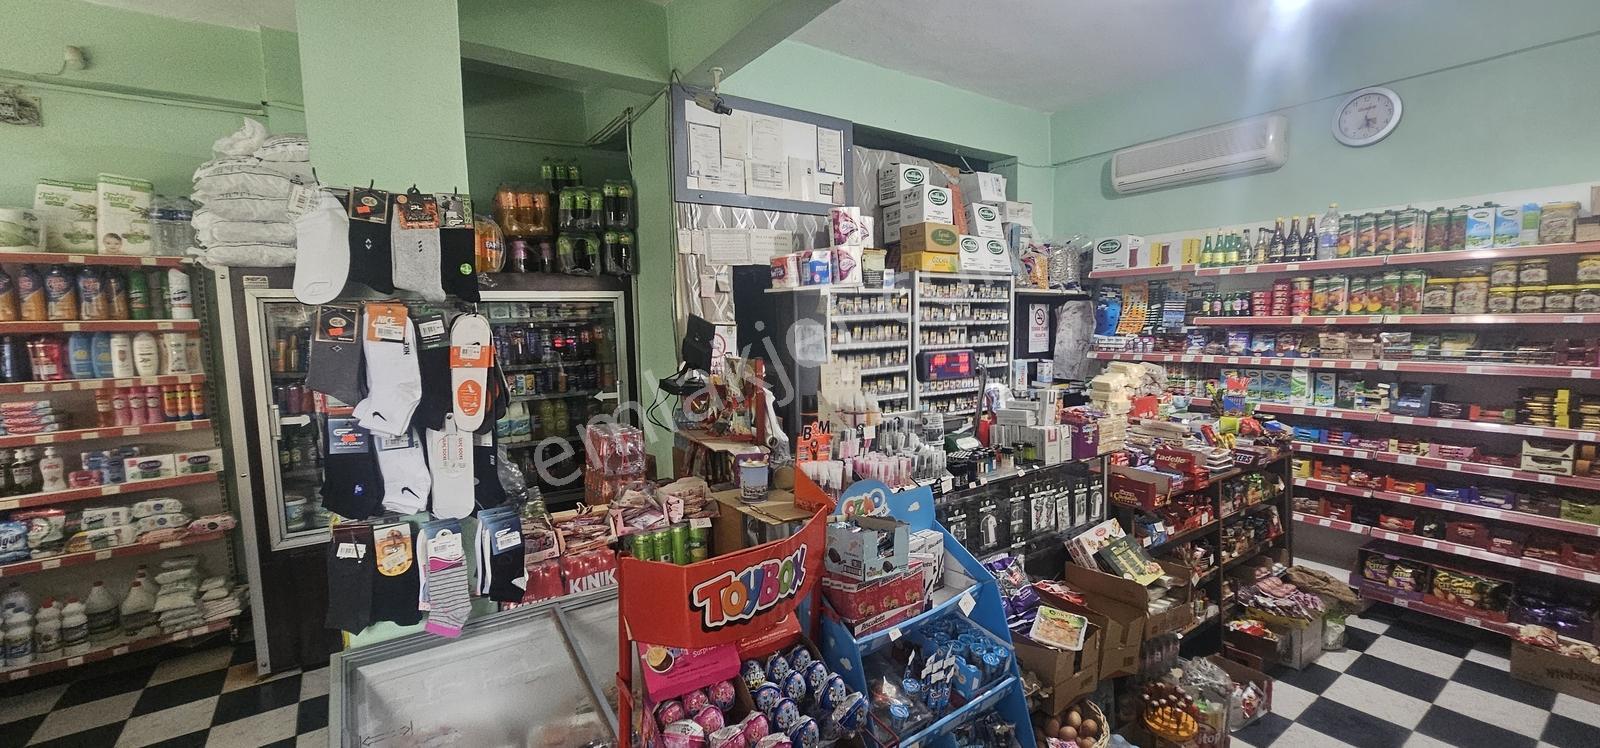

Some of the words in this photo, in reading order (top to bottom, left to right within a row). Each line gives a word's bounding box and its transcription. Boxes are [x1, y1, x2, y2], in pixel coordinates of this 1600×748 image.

[462, 195, 472, 224] SPORT
[802, 419, 831, 442] B&M
[569, 567, 618, 593] KINIK
[696, 545, 806, 625] TOYBOX
[860, 614, 886, 632] Biscolata
